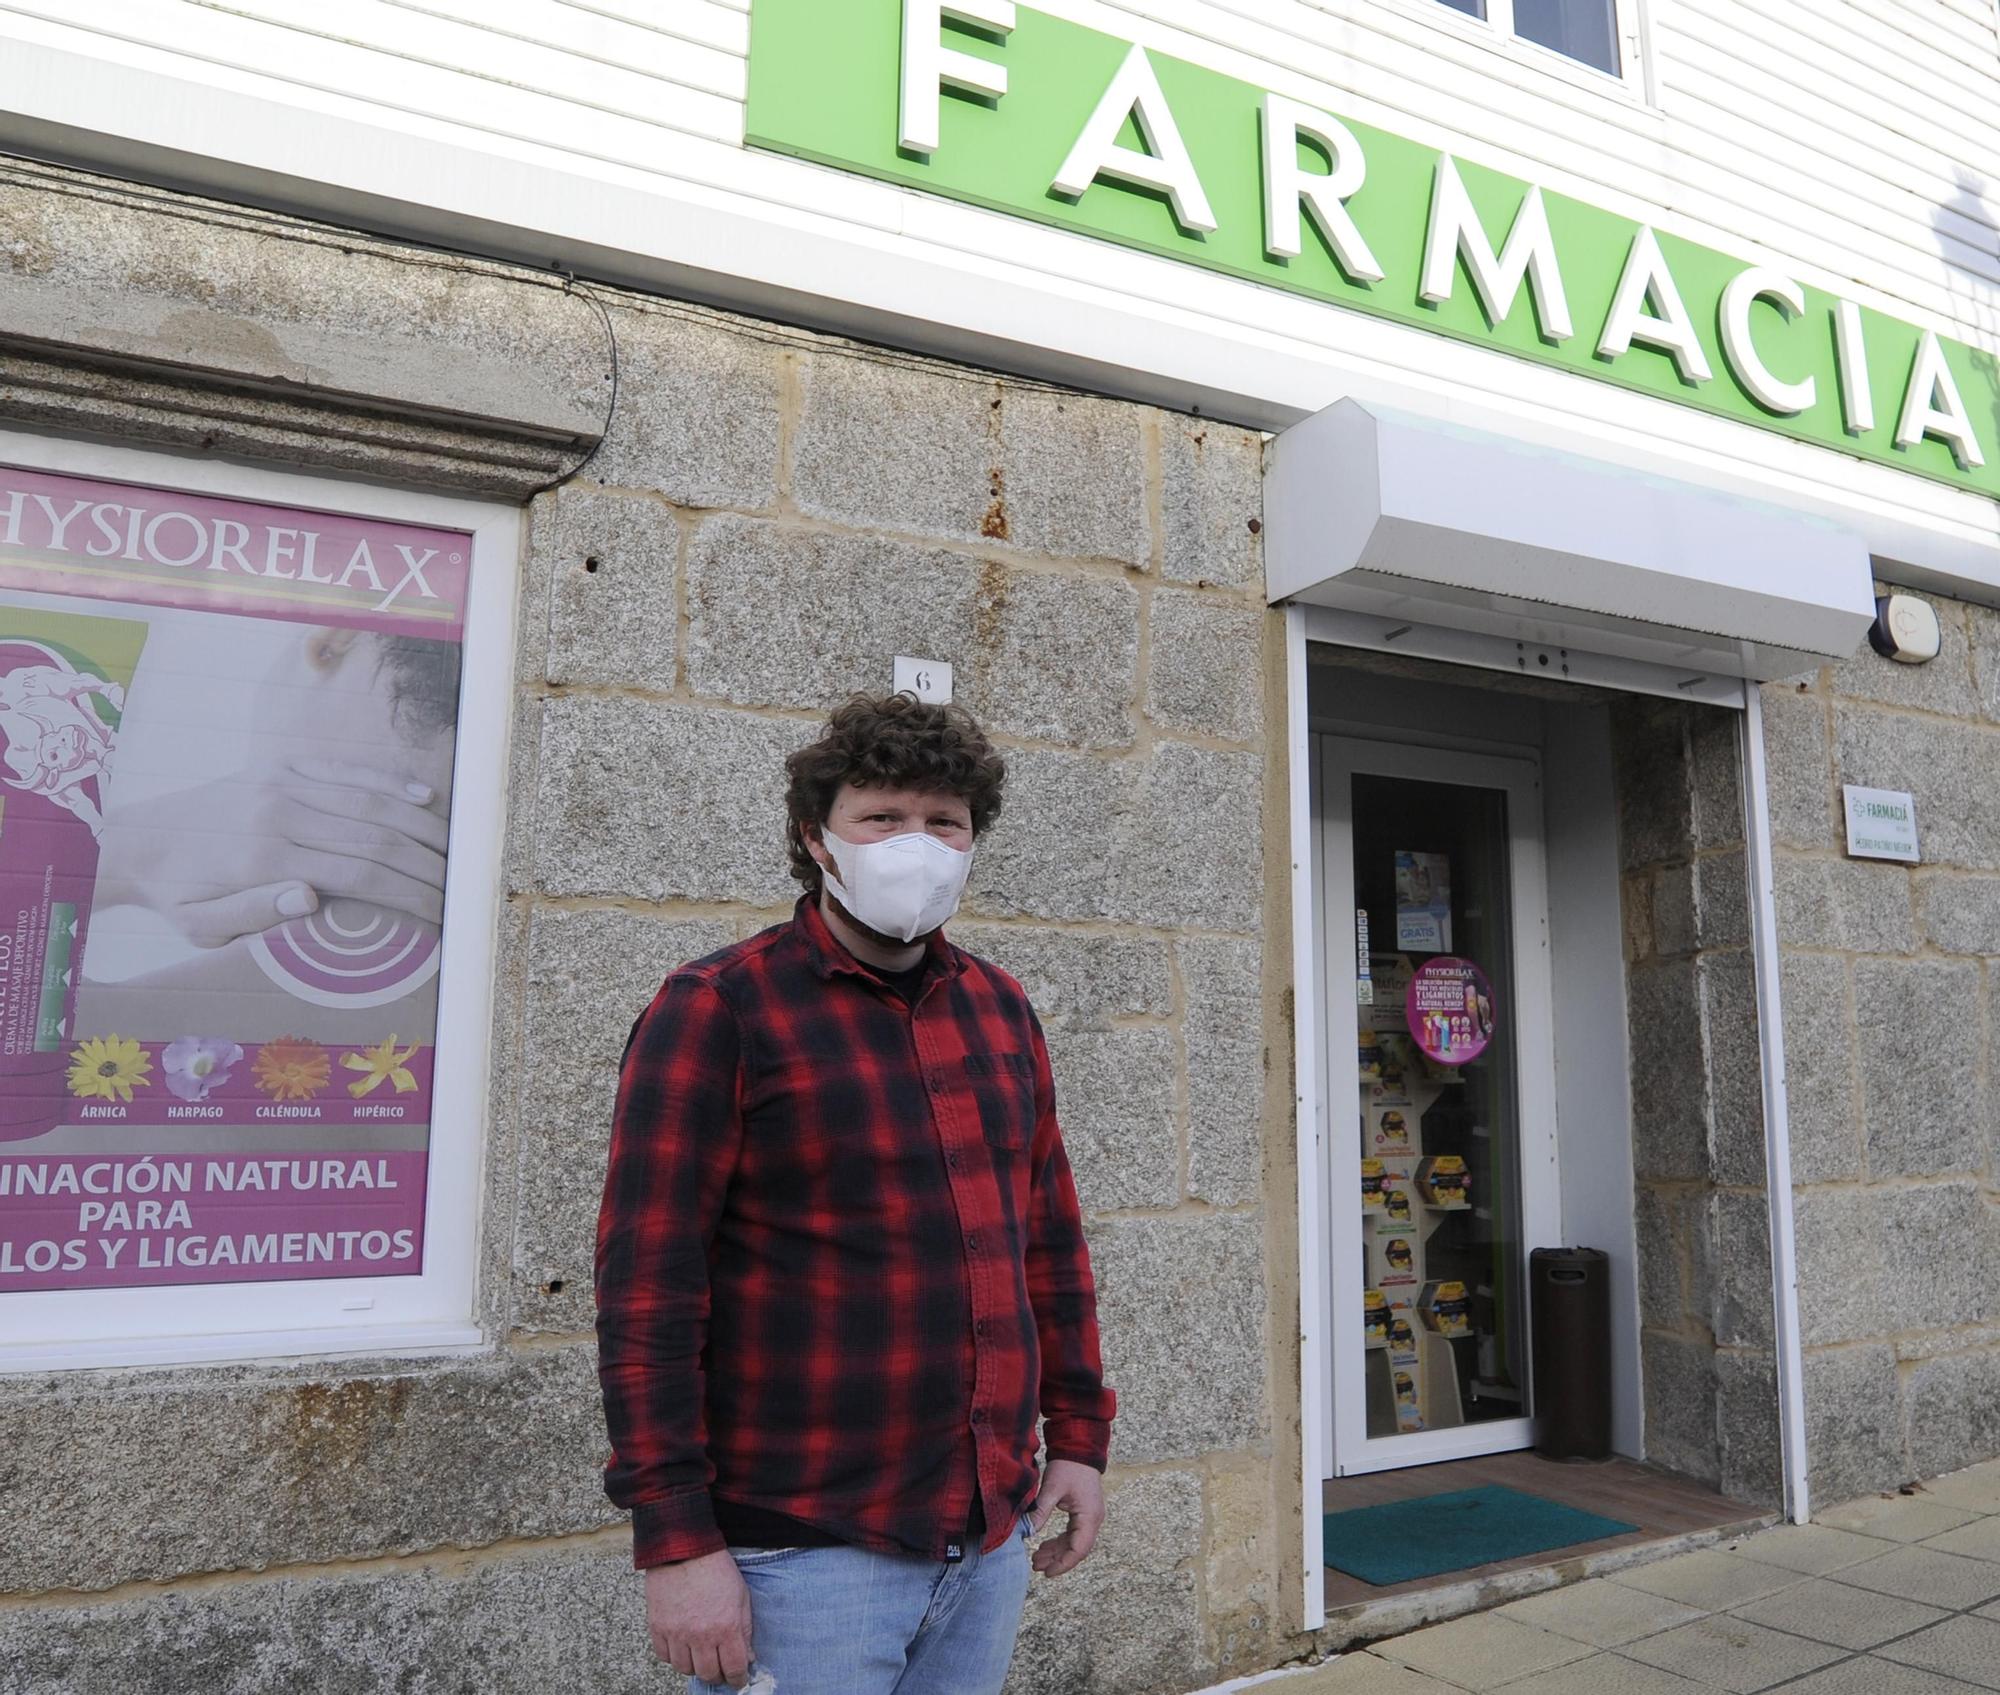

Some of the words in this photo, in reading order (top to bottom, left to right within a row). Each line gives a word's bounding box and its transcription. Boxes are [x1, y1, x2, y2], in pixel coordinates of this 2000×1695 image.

[899, 0, 1985, 470] FARMACIA
[915, 671, 932, 692] 6
[80, 1104, 127, 1119] ÁRNICA
[167, 1106, 224, 1119] HARPAGO
[256, 1104, 321, 1118] CALÉNDULA
[353, 1104, 404, 1118] HIPÉRICO
[0, 1156, 192, 1196] INACIÓN
[205, 1160, 398, 1192] NATURAL
[78, 1200, 193, 1232] PARA
[0, 1239, 87, 1273] LOS
[98, 1238, 128, 1269] Y
[138, 1229, 414, 1269] LIGAMENTOS
